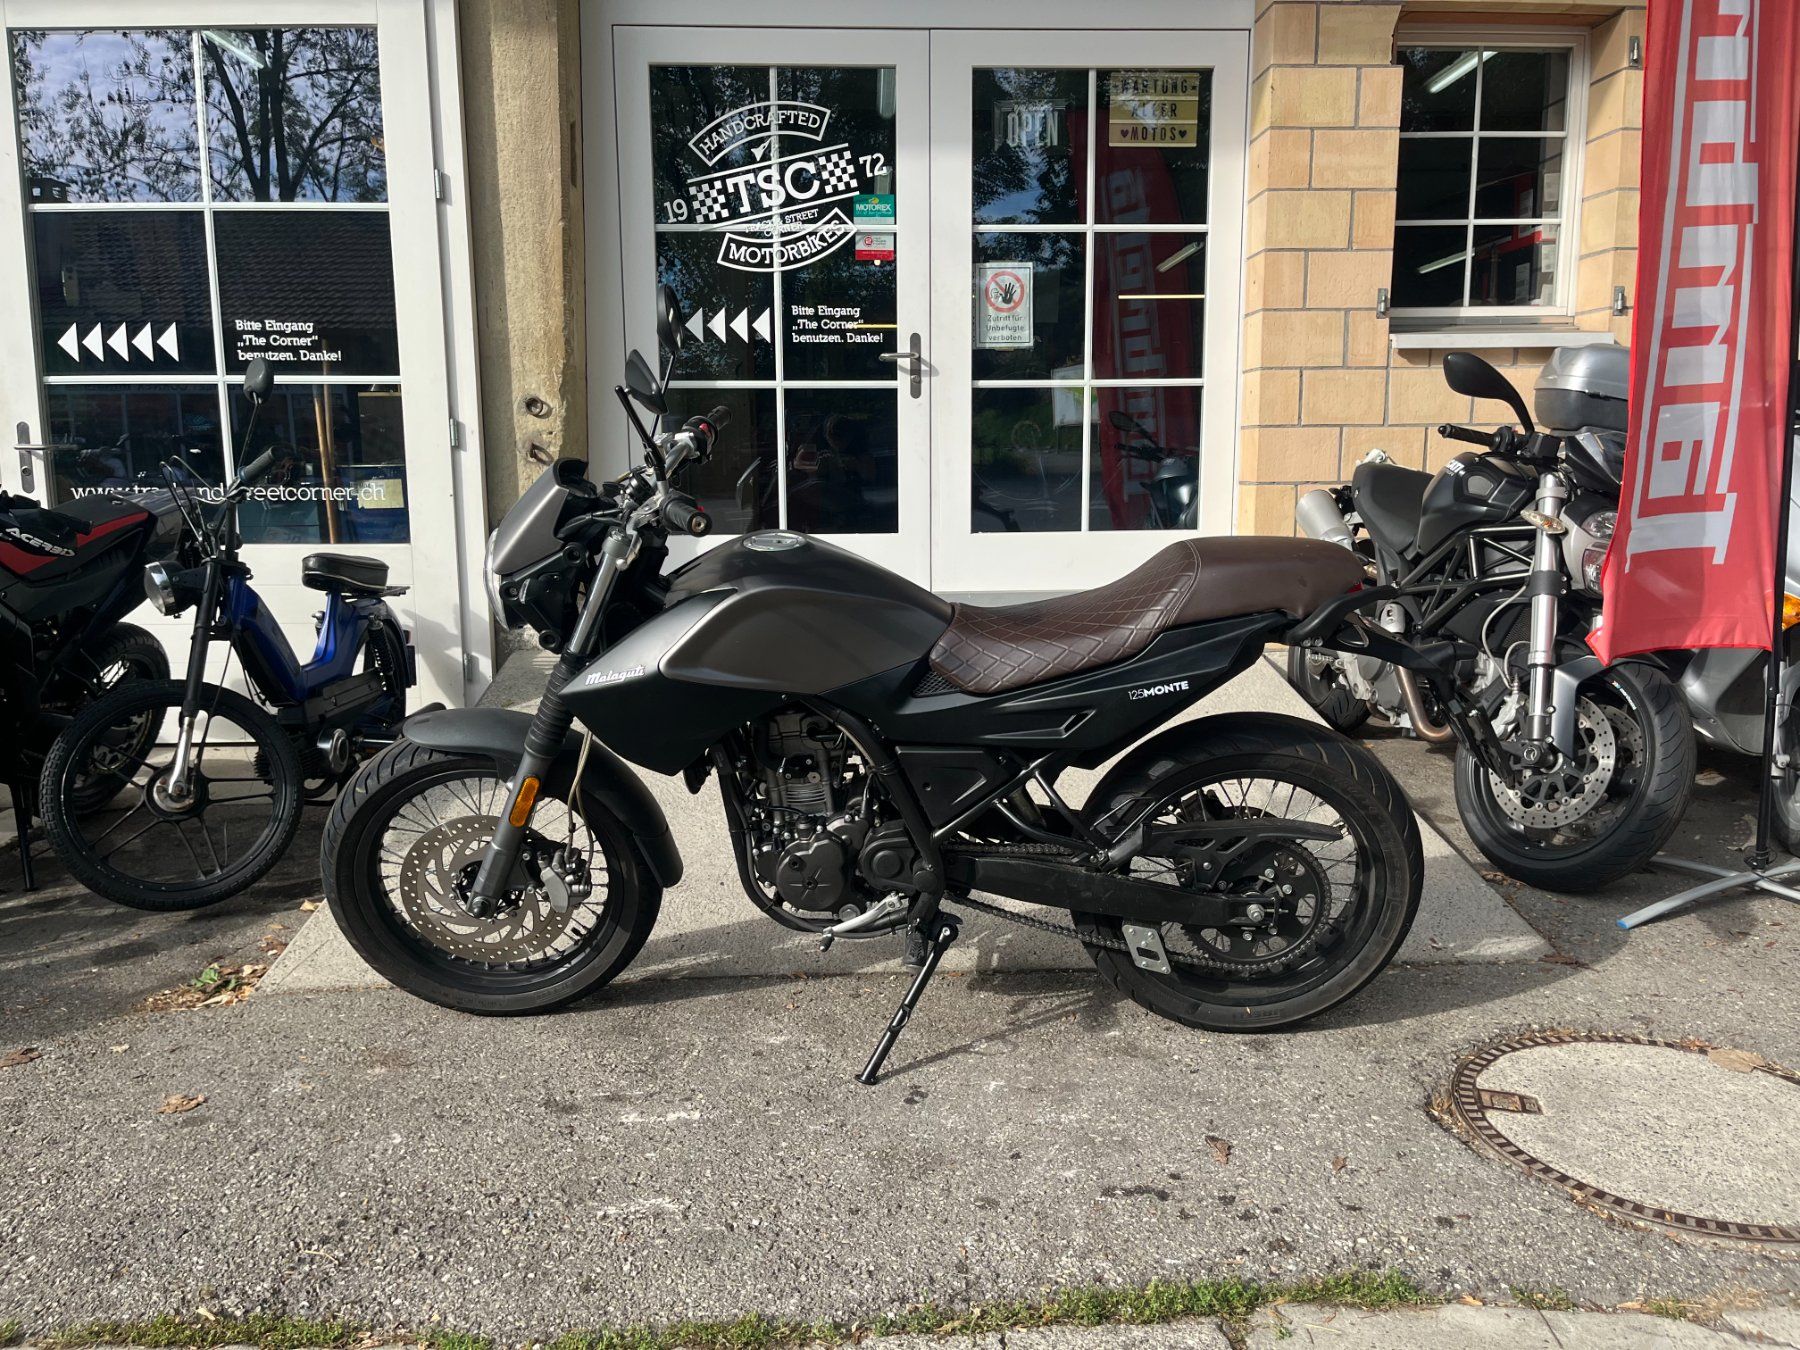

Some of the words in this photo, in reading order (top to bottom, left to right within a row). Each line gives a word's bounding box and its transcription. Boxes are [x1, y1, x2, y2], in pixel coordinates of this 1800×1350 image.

[699, 110, 821, 155] HANDCRAFTED
[1007, 112, 1059, 147] OPEN
[1130, 126, 1177, 141] MOTOS
[663, 198, 688, 224] 19
[726, 161, 821, 215] TSC
[859, 152, 887, 178] 72
[855, 203, 892, 211] MOTOREX
[785, 208, 819, 223] STREET
[729, 219, 845, 264] MOTORBIKES
[791, 305, 815, 316] Bitte
[817, 305, 861, 318] Eingang
[235, 319, 262, 331] Bitte
[264, 319, 314, 333] Eingang
[792, 332, 844, 343] benutzen.
[846, 332, 883, 343] Danke!
[299, 350, 342, 361] Danke!
[585, 664, 646, 685] Malaguti
